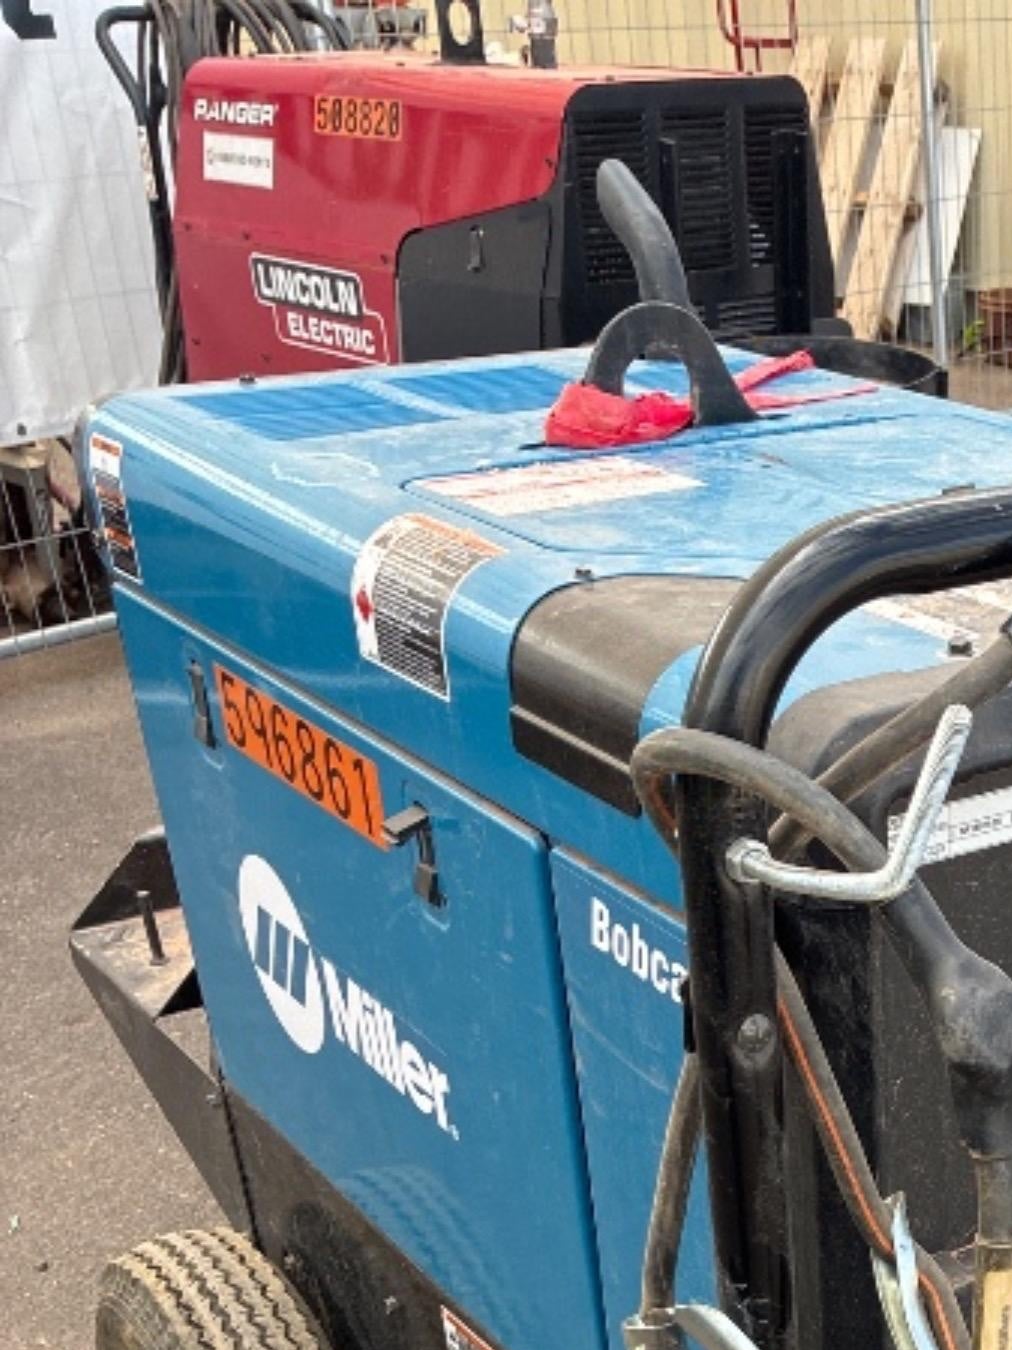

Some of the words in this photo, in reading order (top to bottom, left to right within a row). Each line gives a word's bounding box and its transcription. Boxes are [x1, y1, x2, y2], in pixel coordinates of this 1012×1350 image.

[194, 99, 275, 126] RANGER
[317, 98, 400, 137] 508820
[256, 263, 359, 317] LINCOLN
[287, 311, 376, 355] ELECTRIC
[221, 671, 373, 836] 596861
[590, 896, 689, 1004] Bobca
[320, 956, 452, 1133] Miller
